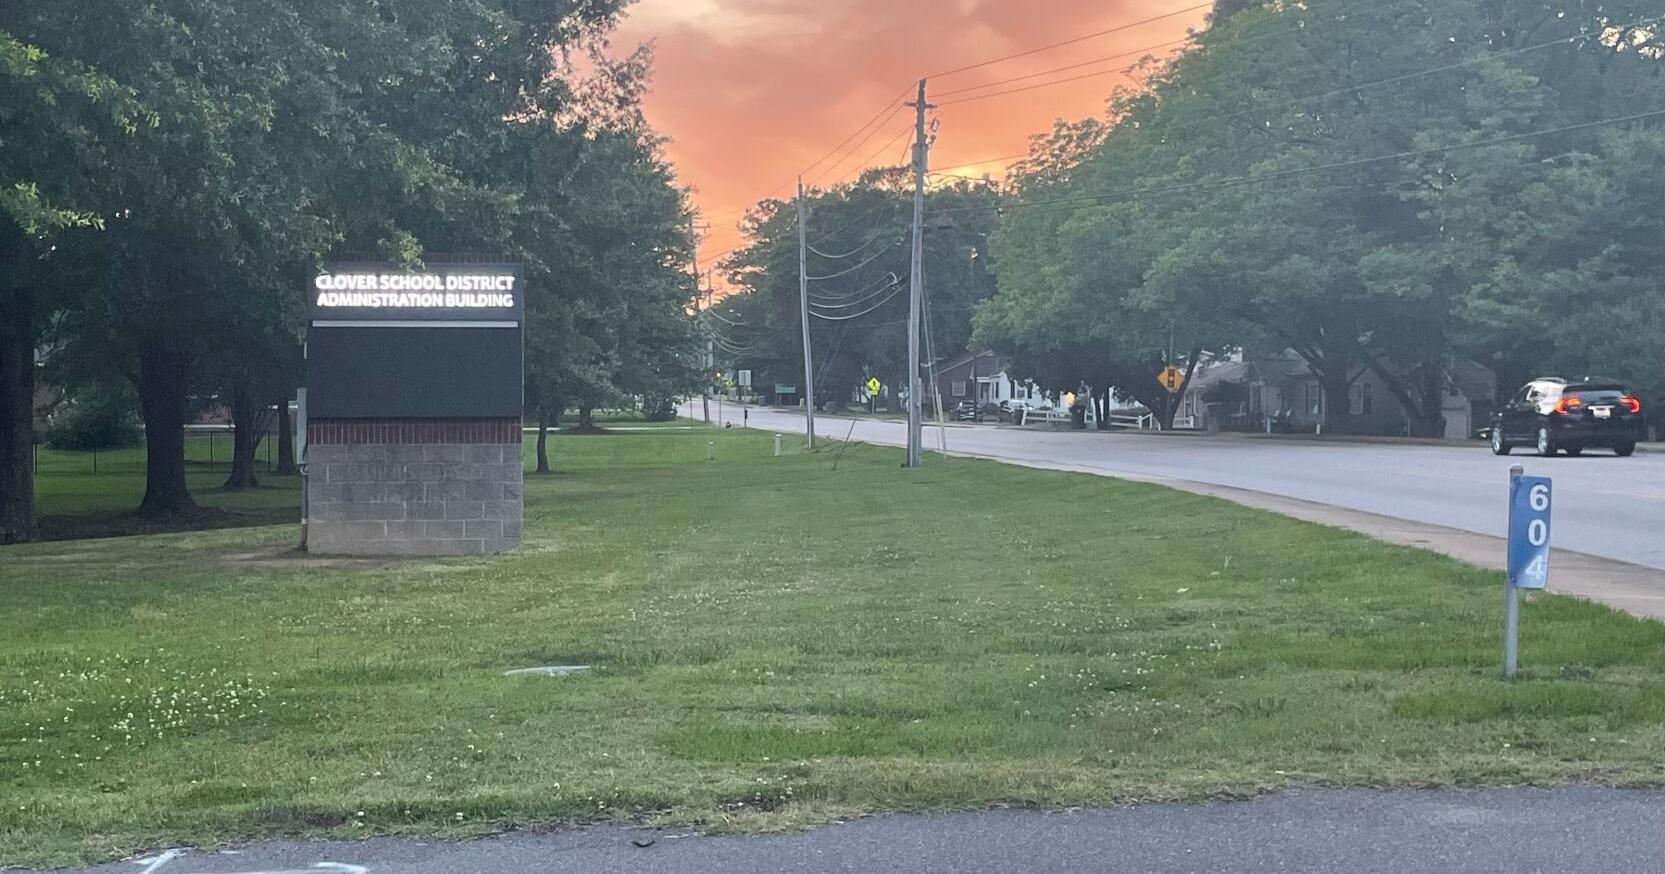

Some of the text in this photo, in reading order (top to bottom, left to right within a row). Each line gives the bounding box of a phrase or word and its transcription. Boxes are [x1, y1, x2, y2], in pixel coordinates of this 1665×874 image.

[315, 274, 515, 290] CLOVER SCHOOL DISTRICT
[316, 293, 514, 308] ADMINISTRATION BUILDING
[1525, 484, 1549, 580] 604
